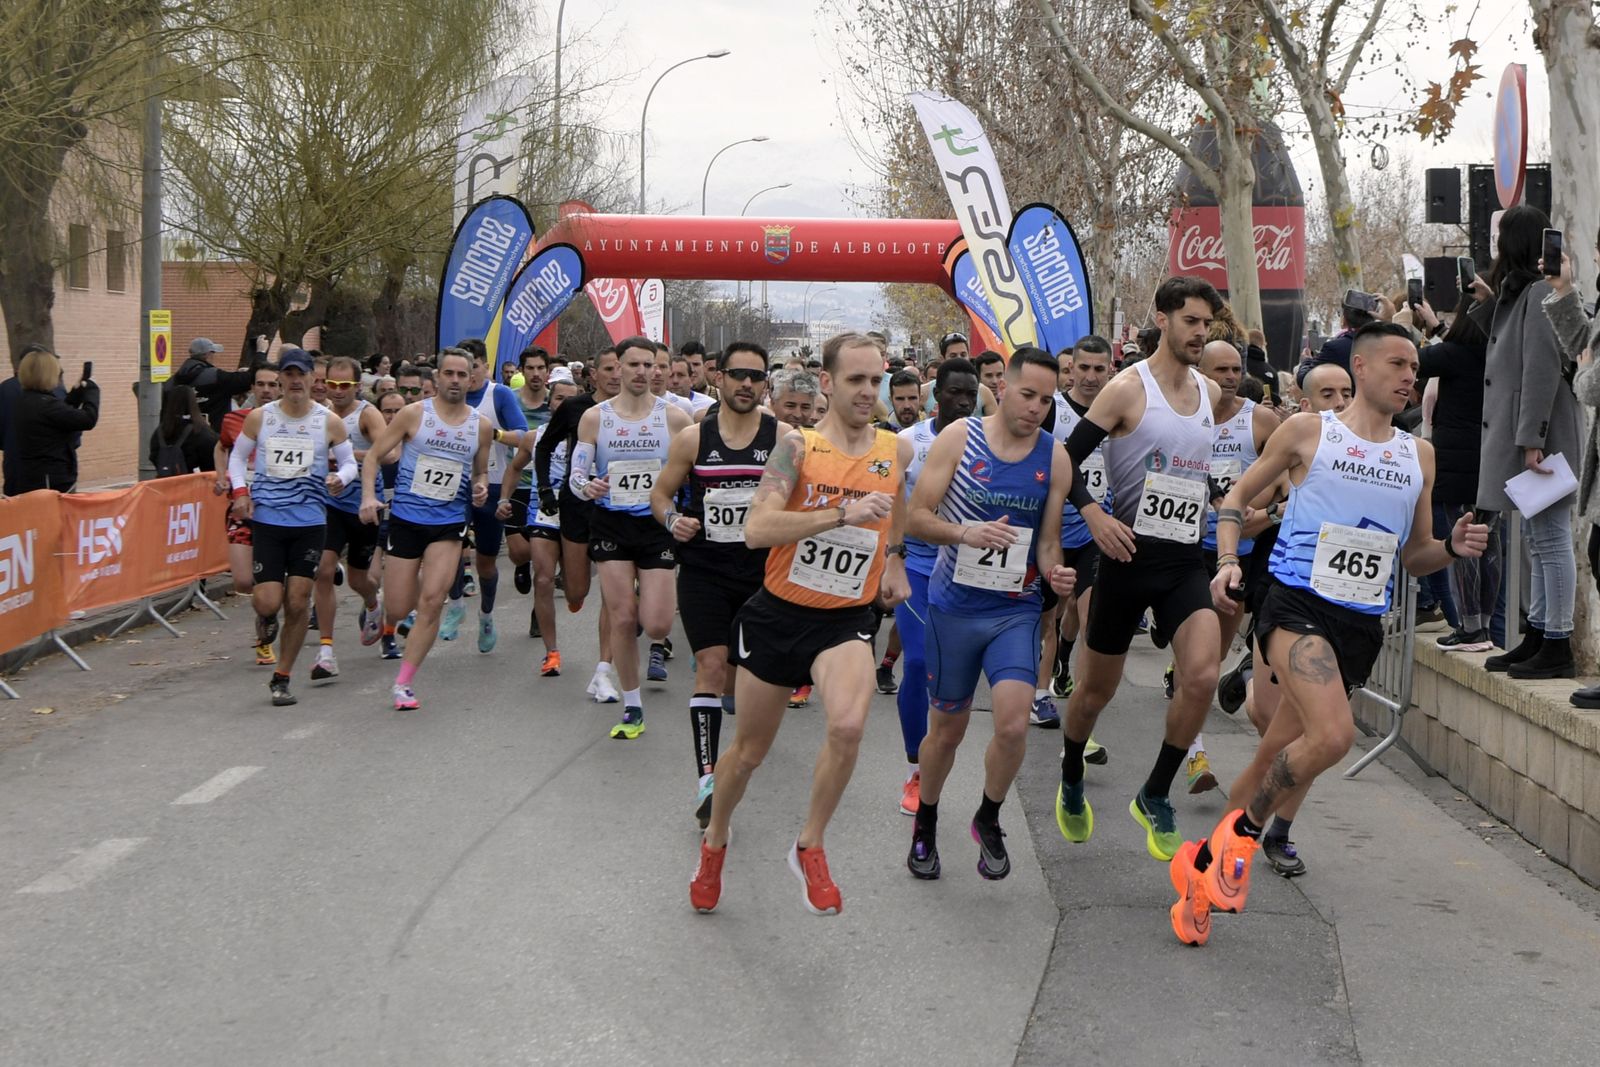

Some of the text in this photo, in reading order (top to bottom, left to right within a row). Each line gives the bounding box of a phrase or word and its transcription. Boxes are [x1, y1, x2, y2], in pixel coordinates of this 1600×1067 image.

[584, 239, 946, 256] AYUNTAMIENTO DE ALBOLOTE
[424, 438, 472, 454] MARACENA
[608, 439, 661, 449] MARACENA
[274, 450, 304, 465] 741
[423, 469, 454, 487] 127
[618, 473, 653, 491] 473
[1331, 459, 1412, 487] MARACENA
[816, 483, 840, 494] Club
[708, 506, 748, 526] 307
[1143, 494, 1199, 525] 3042
[800, 540, 870, 577] 3107
[978, 547, 1009, 569] 21
[1328, 549, 1382, 580] 465
